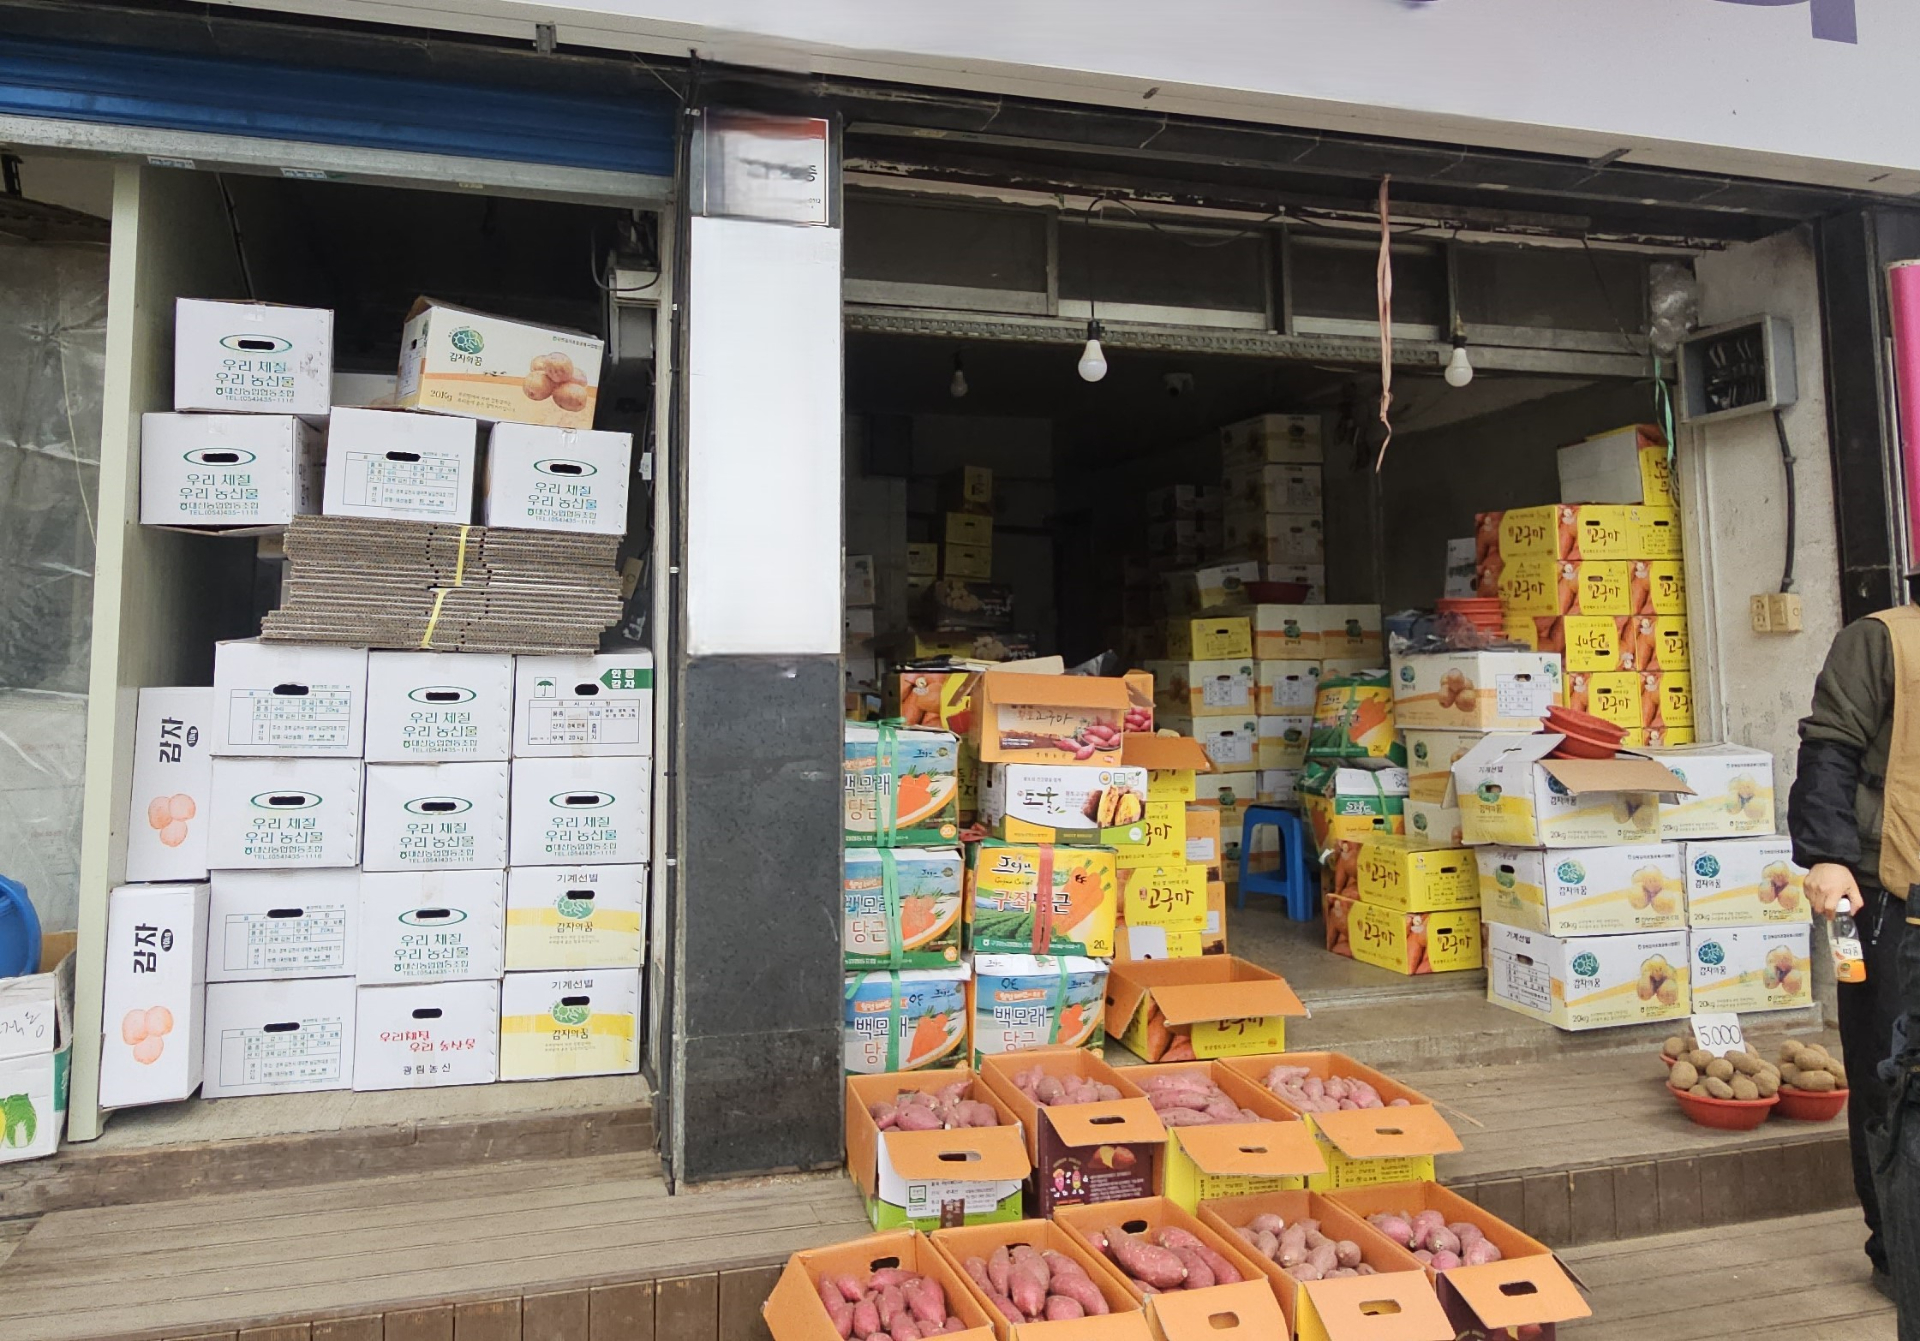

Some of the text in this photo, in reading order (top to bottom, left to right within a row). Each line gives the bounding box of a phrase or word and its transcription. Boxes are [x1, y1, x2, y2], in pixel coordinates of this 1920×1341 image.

[223, 359, 251, 372] 우리
[215, 372, 244, 385] 우리
[186, 474, 215, 486] 우리
[179, 488, 209, 500] 우리
[534, 482, 561, 495] 우리
[527, 494, 555, 507] 우리
[1514, 526, 1546, 546] 고구마
[1590, 529, 1621, 546] 고구마
[1513, 580, 1546, 601] 고구마
[1591, 583, 1621, 602] 고구마
[1601, 695, 1631, 714] 고구마
[410, 712, 438, 724] 우리
[402, 726, 431, 738] 우리
[159, 716, 184, 763] 감자
[252, 817, 281, 830] 우리
[406, 822, 434, 834] 우리
[551, 817, 579, 828] 우리
[245, 832, 273, 844] 우리
[399, 836, 427, 848] 우리
[545, 830, 572, 842] 우리
[998, 855, 1032, 873] Jeju
[1370, 863, 1401, 889] 고구마
[992, 888, 1072, 915] 구좌근
[1148, 887, 1194, 913] 고구마
[852, 920, 887, 943] 당근
[1364, 922, 1396, 947] 고구마
[400, 934, 429, 947] 우리
[1441, 935, 1473, 954] 고구마
[133, 923, 158, 974] 감자
[393, 948, 422, 961] 우리
[994, 1006, 1046, 1028] 백모래
[1697, 1024, 1742, 1046] 5.000
[410, 1038, 476, 1052] 우리 농산물
